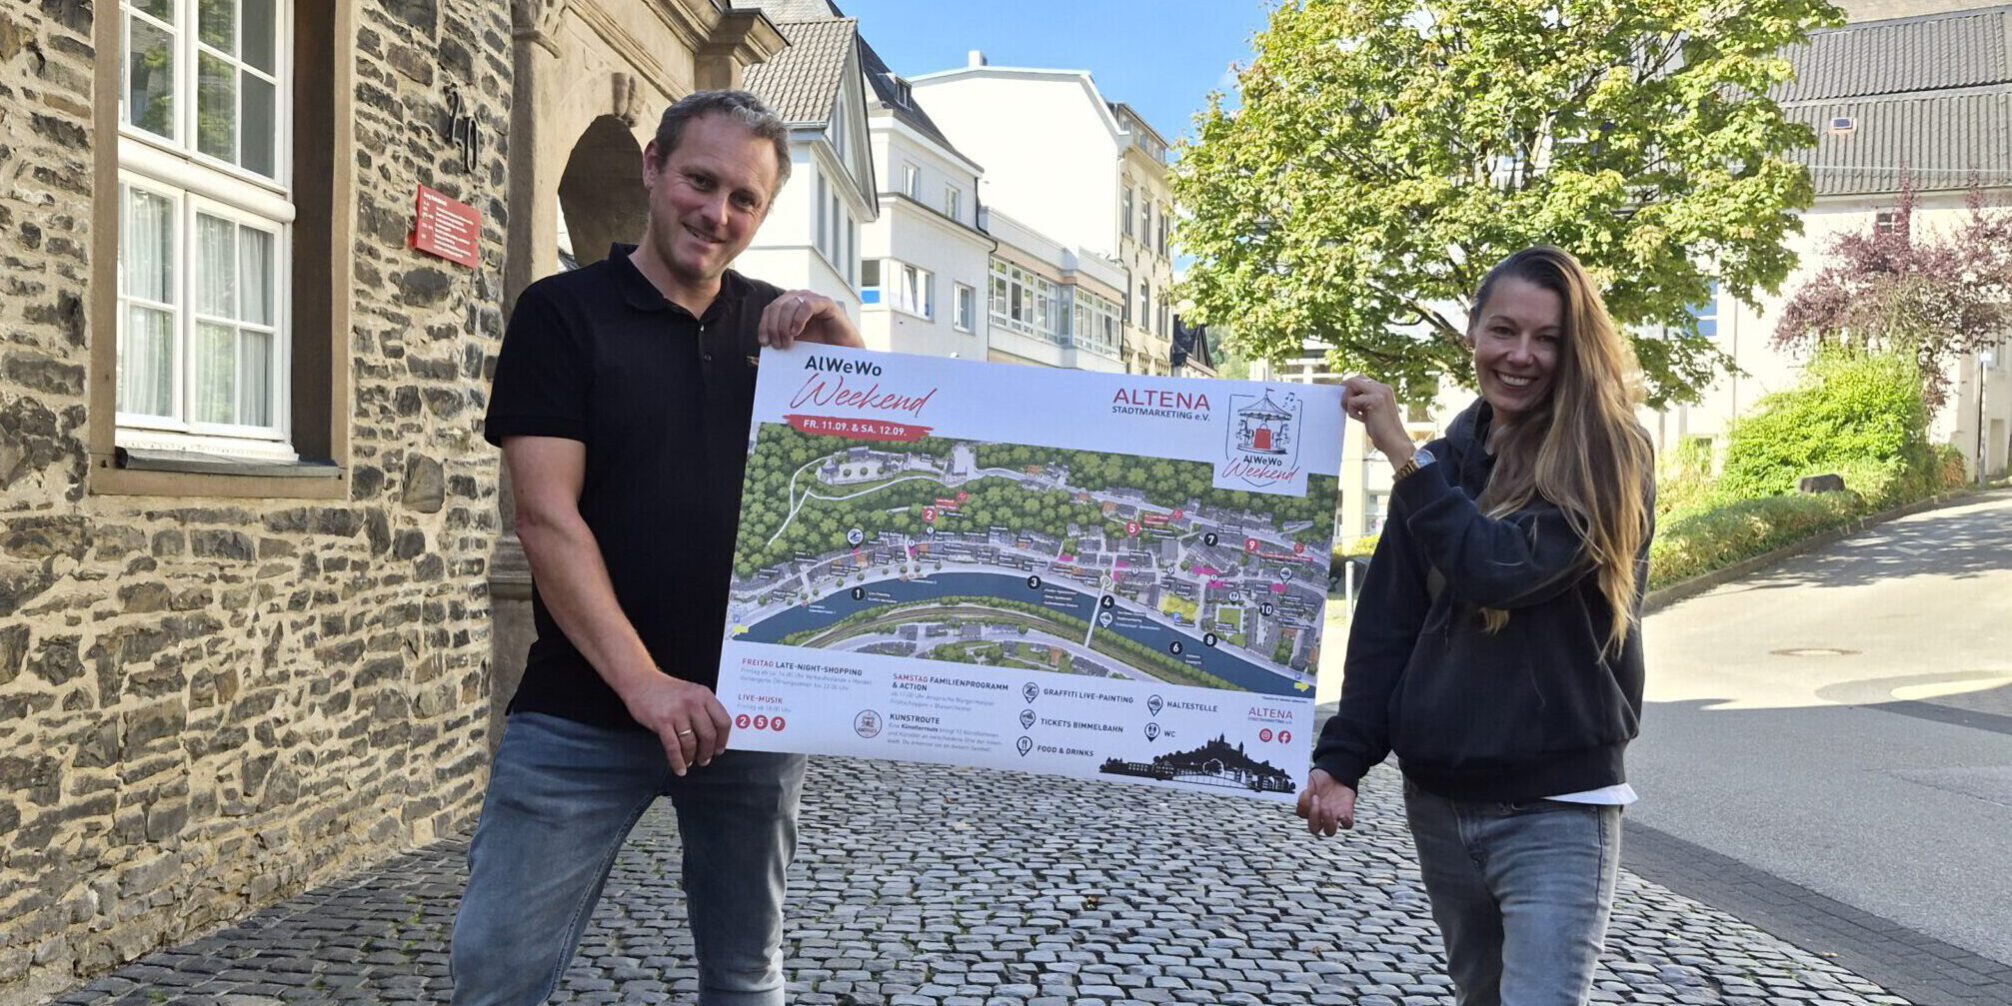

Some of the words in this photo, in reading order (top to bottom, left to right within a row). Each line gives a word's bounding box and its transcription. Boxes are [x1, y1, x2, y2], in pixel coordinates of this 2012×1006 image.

[805, 355, 882, 377] AlWeWo
[790, 373, 938, 418] Weekend
[1113, 388, 1210, 411] ALTENA
[1112, 406, 1192, 420] STADTMARKETING
[1194, 413, 1210, 422] e.V.
[803, 419, 819, 430] FR.
[822, 421, 849, 432] 11.09.
[851, 423, 859, 432] &
[861, 424, 877, 434] SA.
[879, 426, 908, 437] 12.09.
[1243, 455, 1283, 466] AlWeWo
[1222, 457, 1299, 483] Weekend
[926, 510, 933, 520] 2
[1129, 523, 1136, 533] 5
[1208, 535, 1215, 544] 7
[1249, 541, 1255, 549] 9
[1031, 578, 1037, 587] 3
[855, 588, 861, 598] 1
[1104, 597, 1111, 606] 4
[1261, 604, 1273, 614] 10
[1207, 635, 1213, 645] 8
[1173, 643, 1179, 652] 6
[742, 658, 774, 667] FREITAG
[775, 662, 863, 677] LATE-NIGHT-SHOPPING
[893, 673, 928, 683] SAMSTAG
[929, 676, 1009, 691] FAMILIENPROGRAMM
[899, 682, 928, 691] ACTION
[738, 693, 783, 705] LIVE-MUSIK
[1043, 688, 1077, 698] GRAFFITI
[1079, 691, 1134, 704] LIVE-PAINTING
[1166, 701, 1218, 712] HALTESTELLE
[889, 713, 940, 724] KUNSTROUTE
[1248, 707, 1293, 720] ALTENA
[740, 716, 747, 727] 2
[757, 717, 764, 727] 5
[774, 719, 781, 729] 9
[1041, 718, 1071, 728] TICKETS
[1073, 721, 1124, 733] BIMMELBAHN
[1164, 730, 1176, 738] WC
[1037, 745, 1057, 753] FOOD
[1066, 748, 1094, 757] DRINKS
